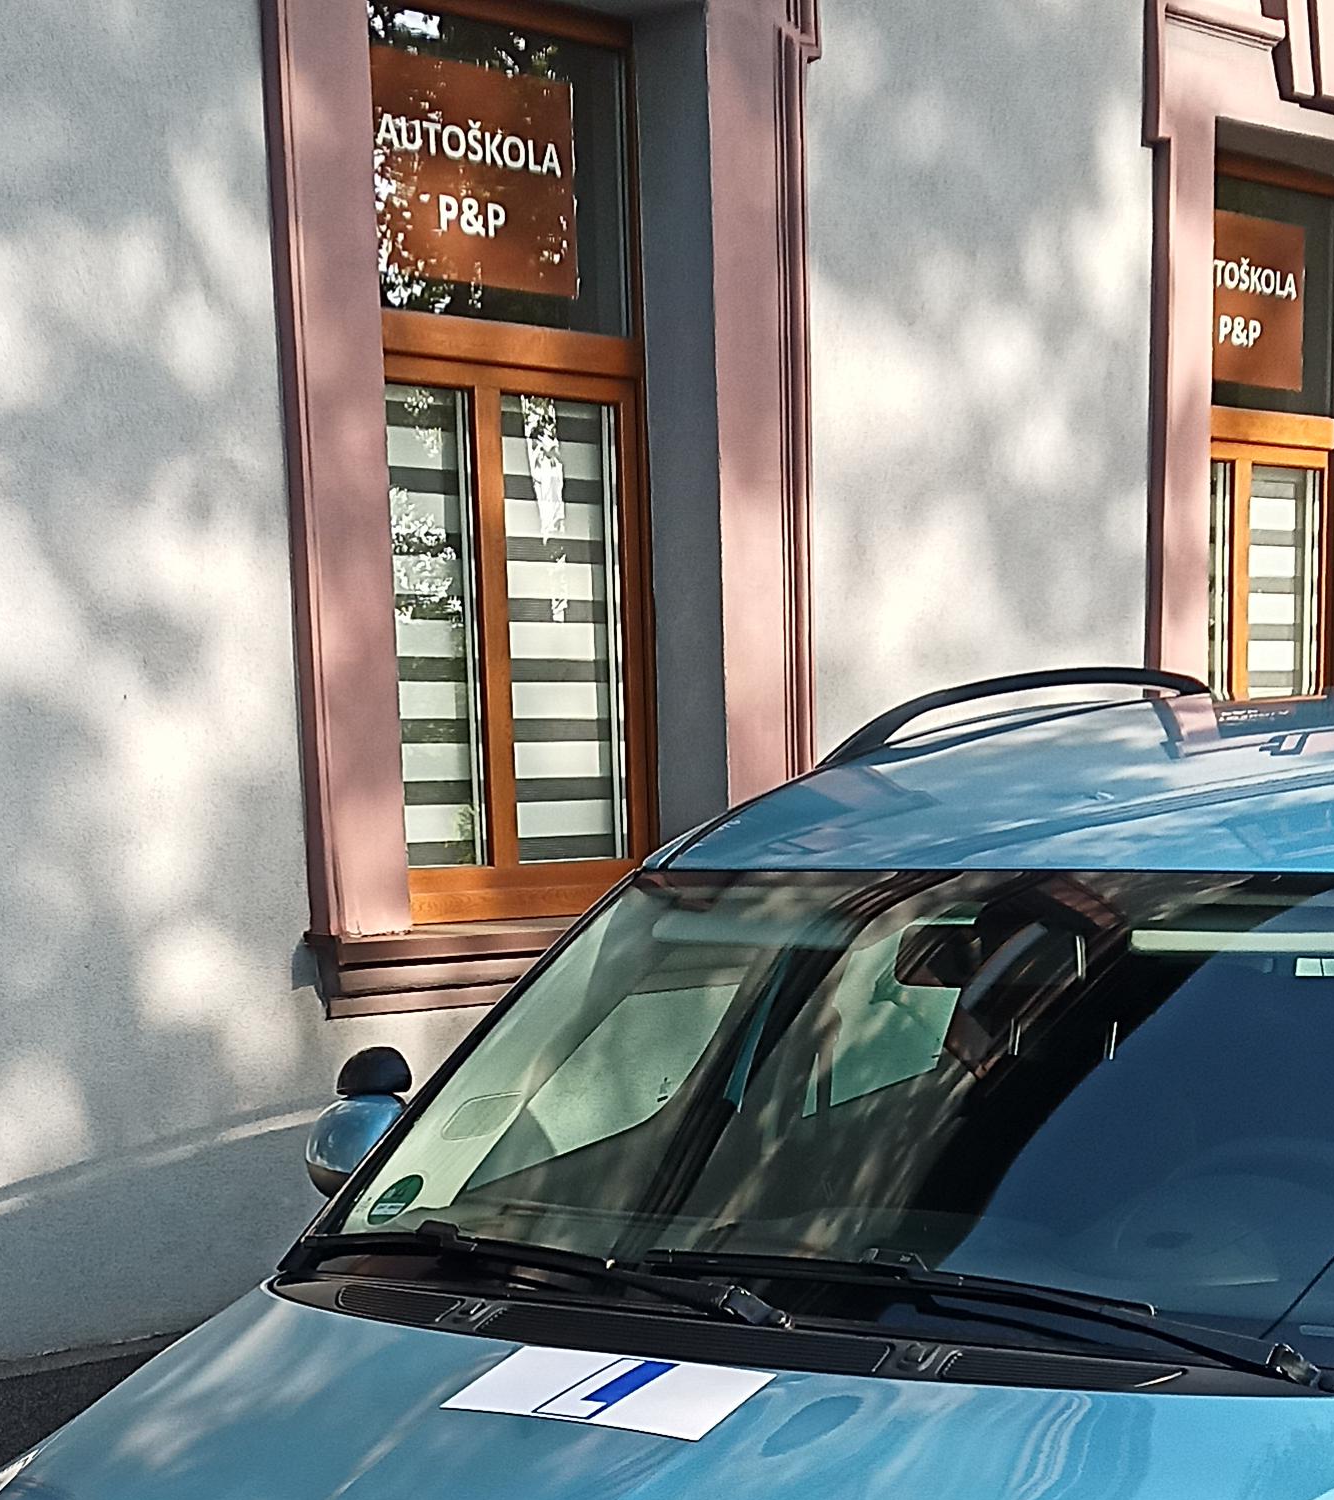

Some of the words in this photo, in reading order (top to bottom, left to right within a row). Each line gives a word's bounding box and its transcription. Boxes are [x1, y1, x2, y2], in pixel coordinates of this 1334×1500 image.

[376, 113, 561, 178] AUTOŠKOLA
[438, 194, 506, 238] P&P
[1213, 257, 1297, 300] TOŠKOLA
[1218, 314, 1261, 347] P&P
